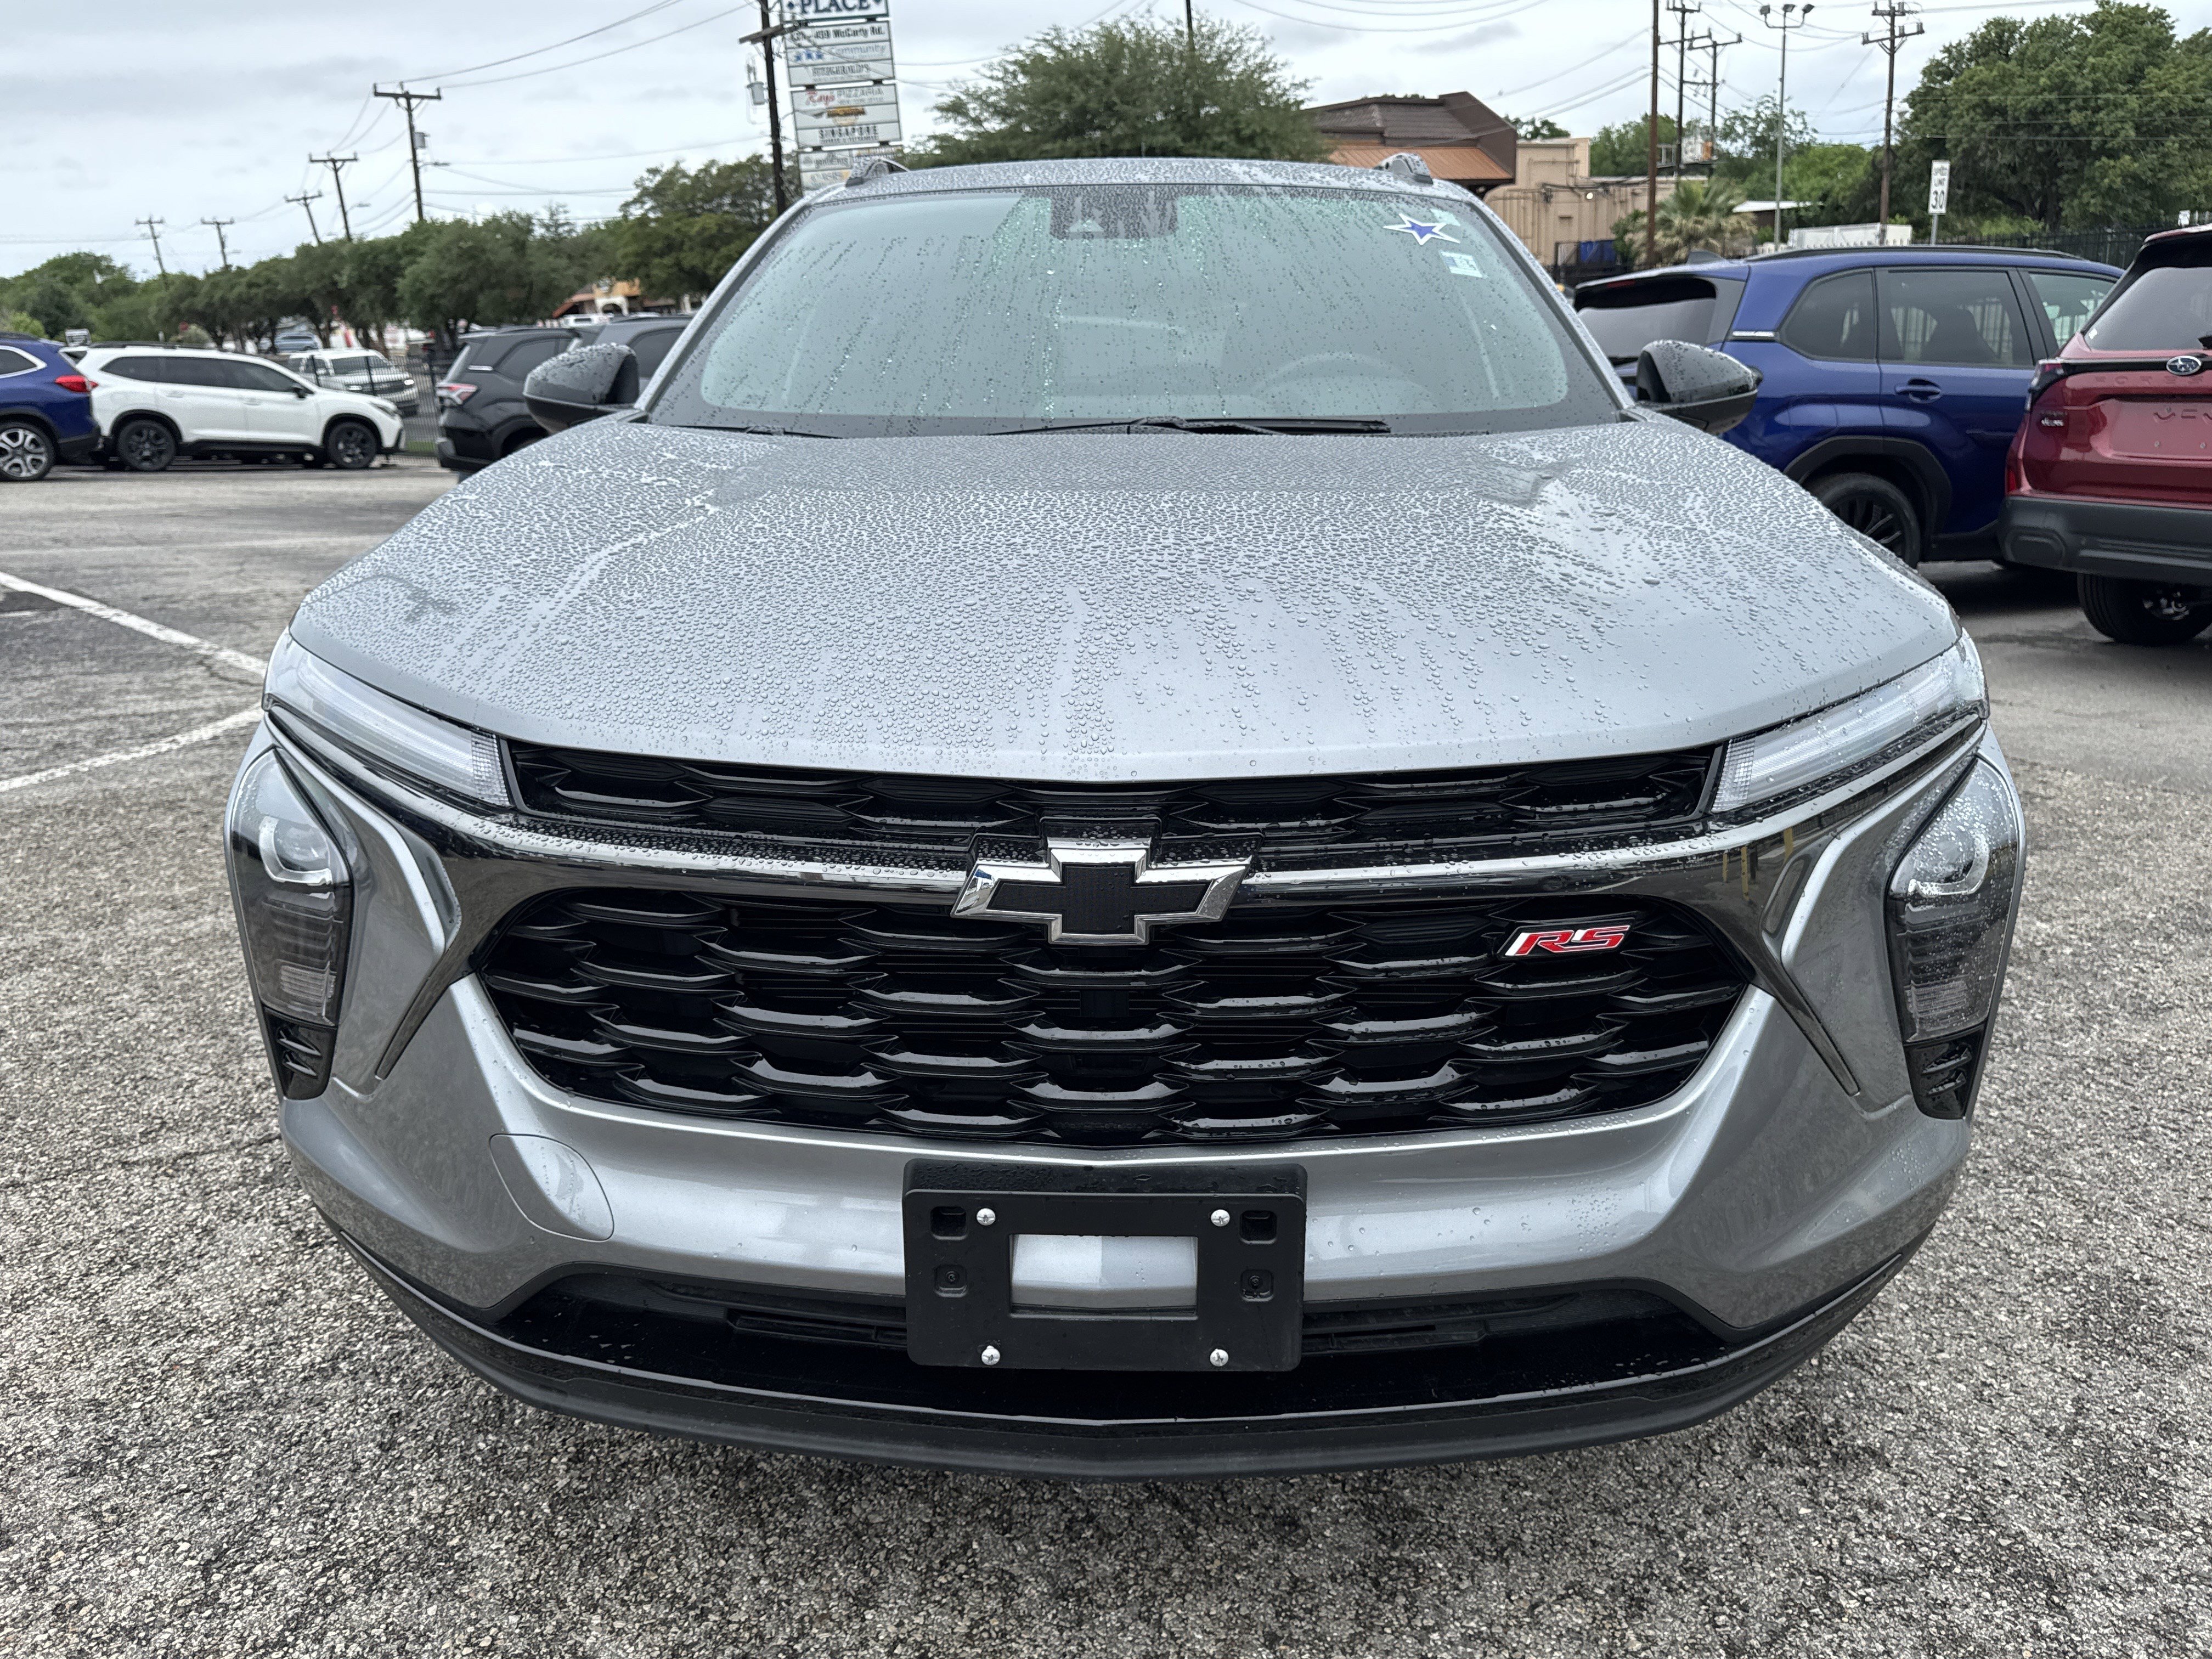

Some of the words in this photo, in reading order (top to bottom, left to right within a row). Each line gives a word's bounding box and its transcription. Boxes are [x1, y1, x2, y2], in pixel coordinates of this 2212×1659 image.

[801, 0, 871, 13] PLACE
[830, 44, 887, 55] Community
[1931, 190, 1945, 208] 30
[1505, 925, 1630, 956] RS
